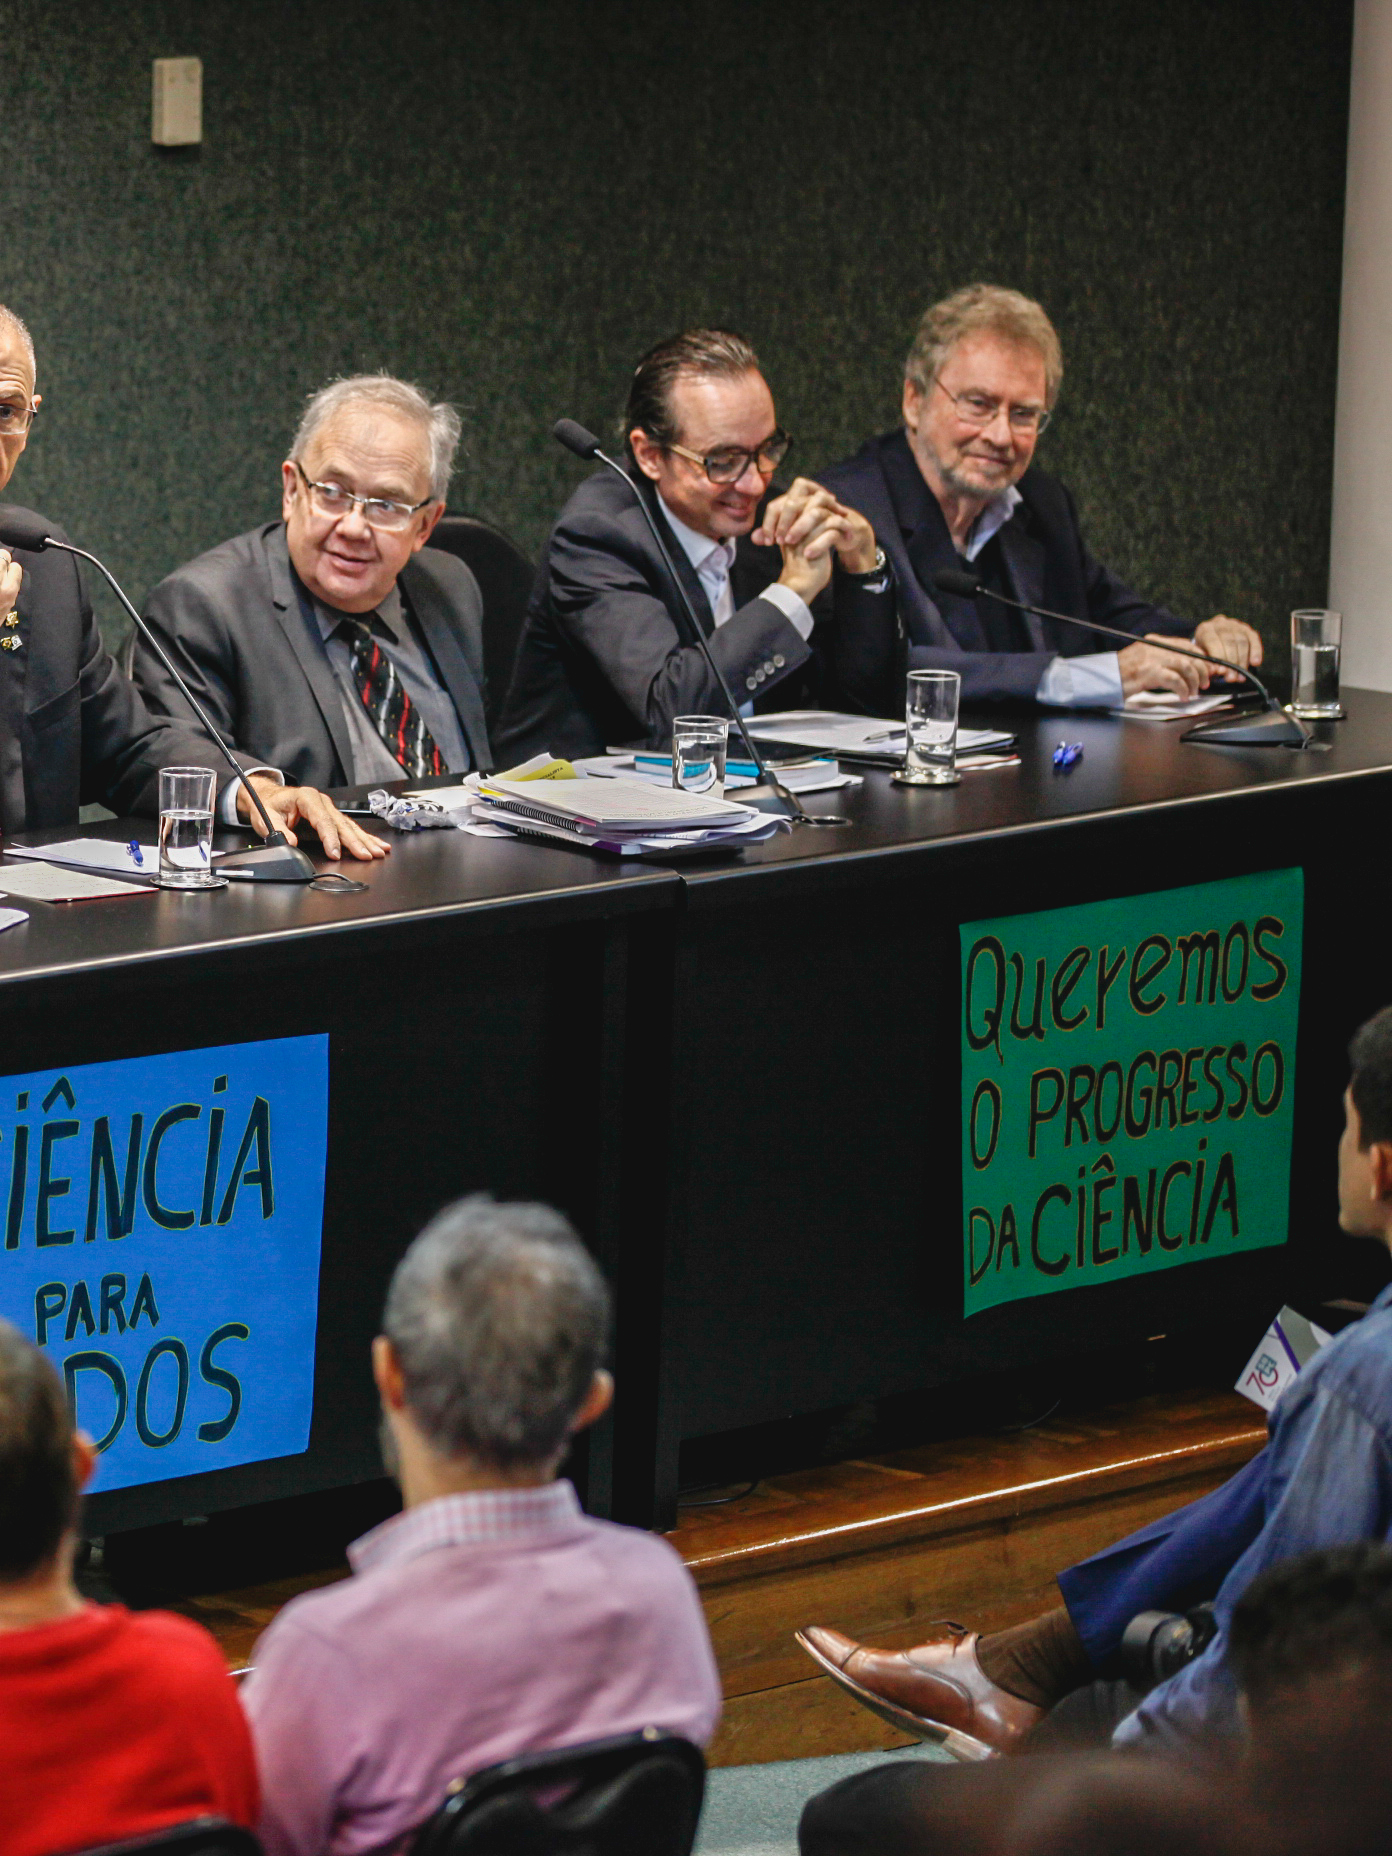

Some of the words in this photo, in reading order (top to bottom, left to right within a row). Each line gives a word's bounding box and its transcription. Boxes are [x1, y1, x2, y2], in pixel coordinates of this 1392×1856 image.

[965, 915, 1288, 1066] Queremos
[969, 1078, 1002, 1171] O
[1028, 1040, 1284, 1159] PROGRESSO
[35, 1271, 160, 1346] PARA
[968, 1203, 1020, 1287] DA
[63, 1321, 250, 1457] DOS
